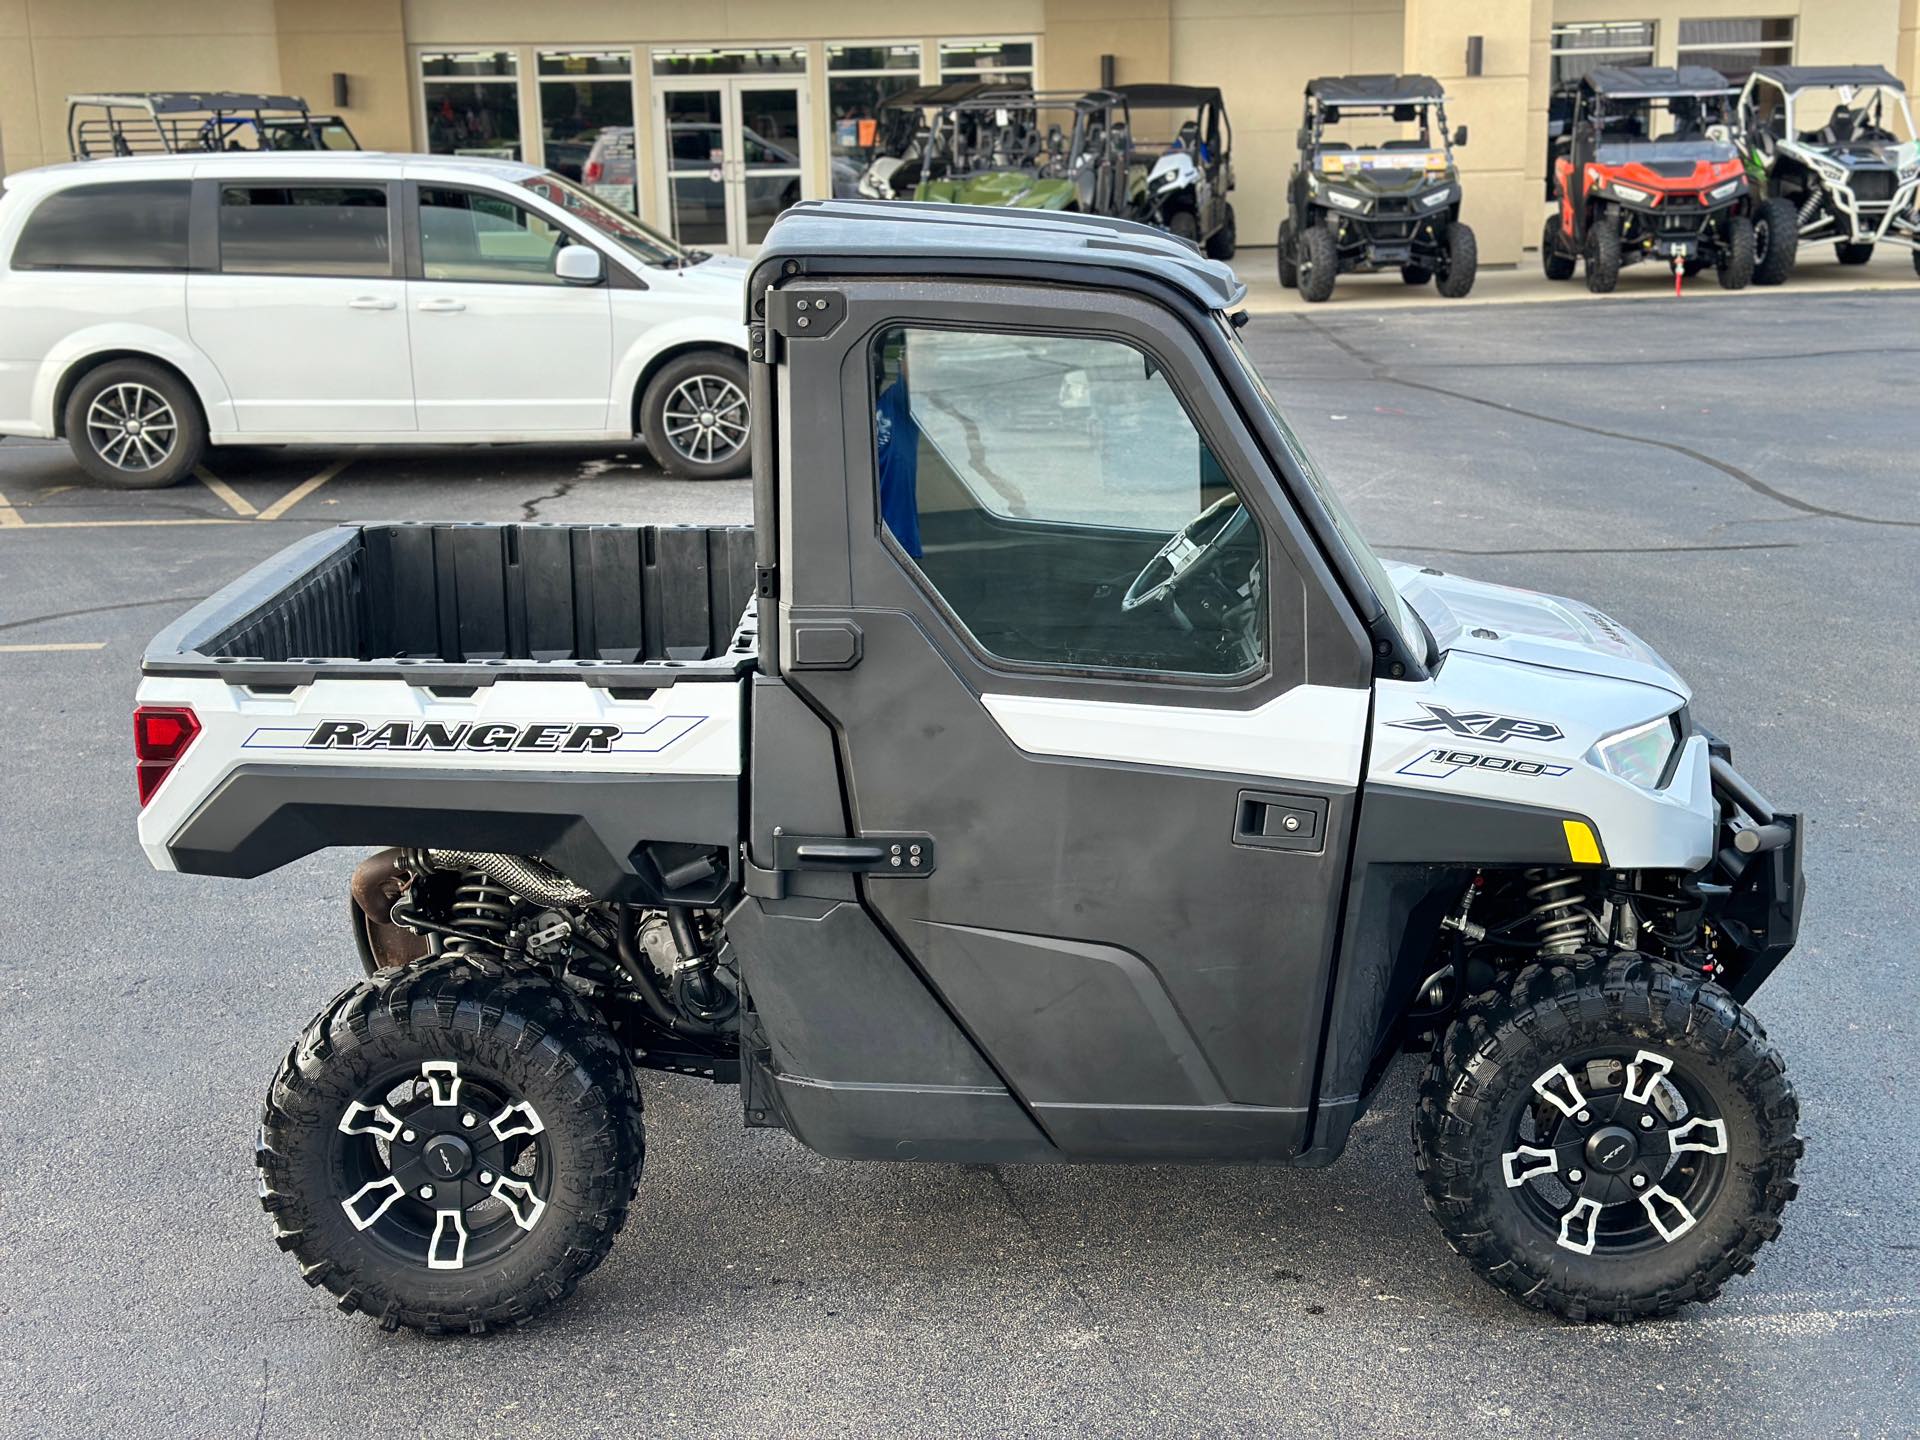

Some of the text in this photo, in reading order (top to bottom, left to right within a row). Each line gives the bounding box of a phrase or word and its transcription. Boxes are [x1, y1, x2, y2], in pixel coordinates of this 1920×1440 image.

[304, 719, 623, 752] RANGER
[1381, 702, 1565, 743] XP
[1431, 750, 1548, 777] 1000
